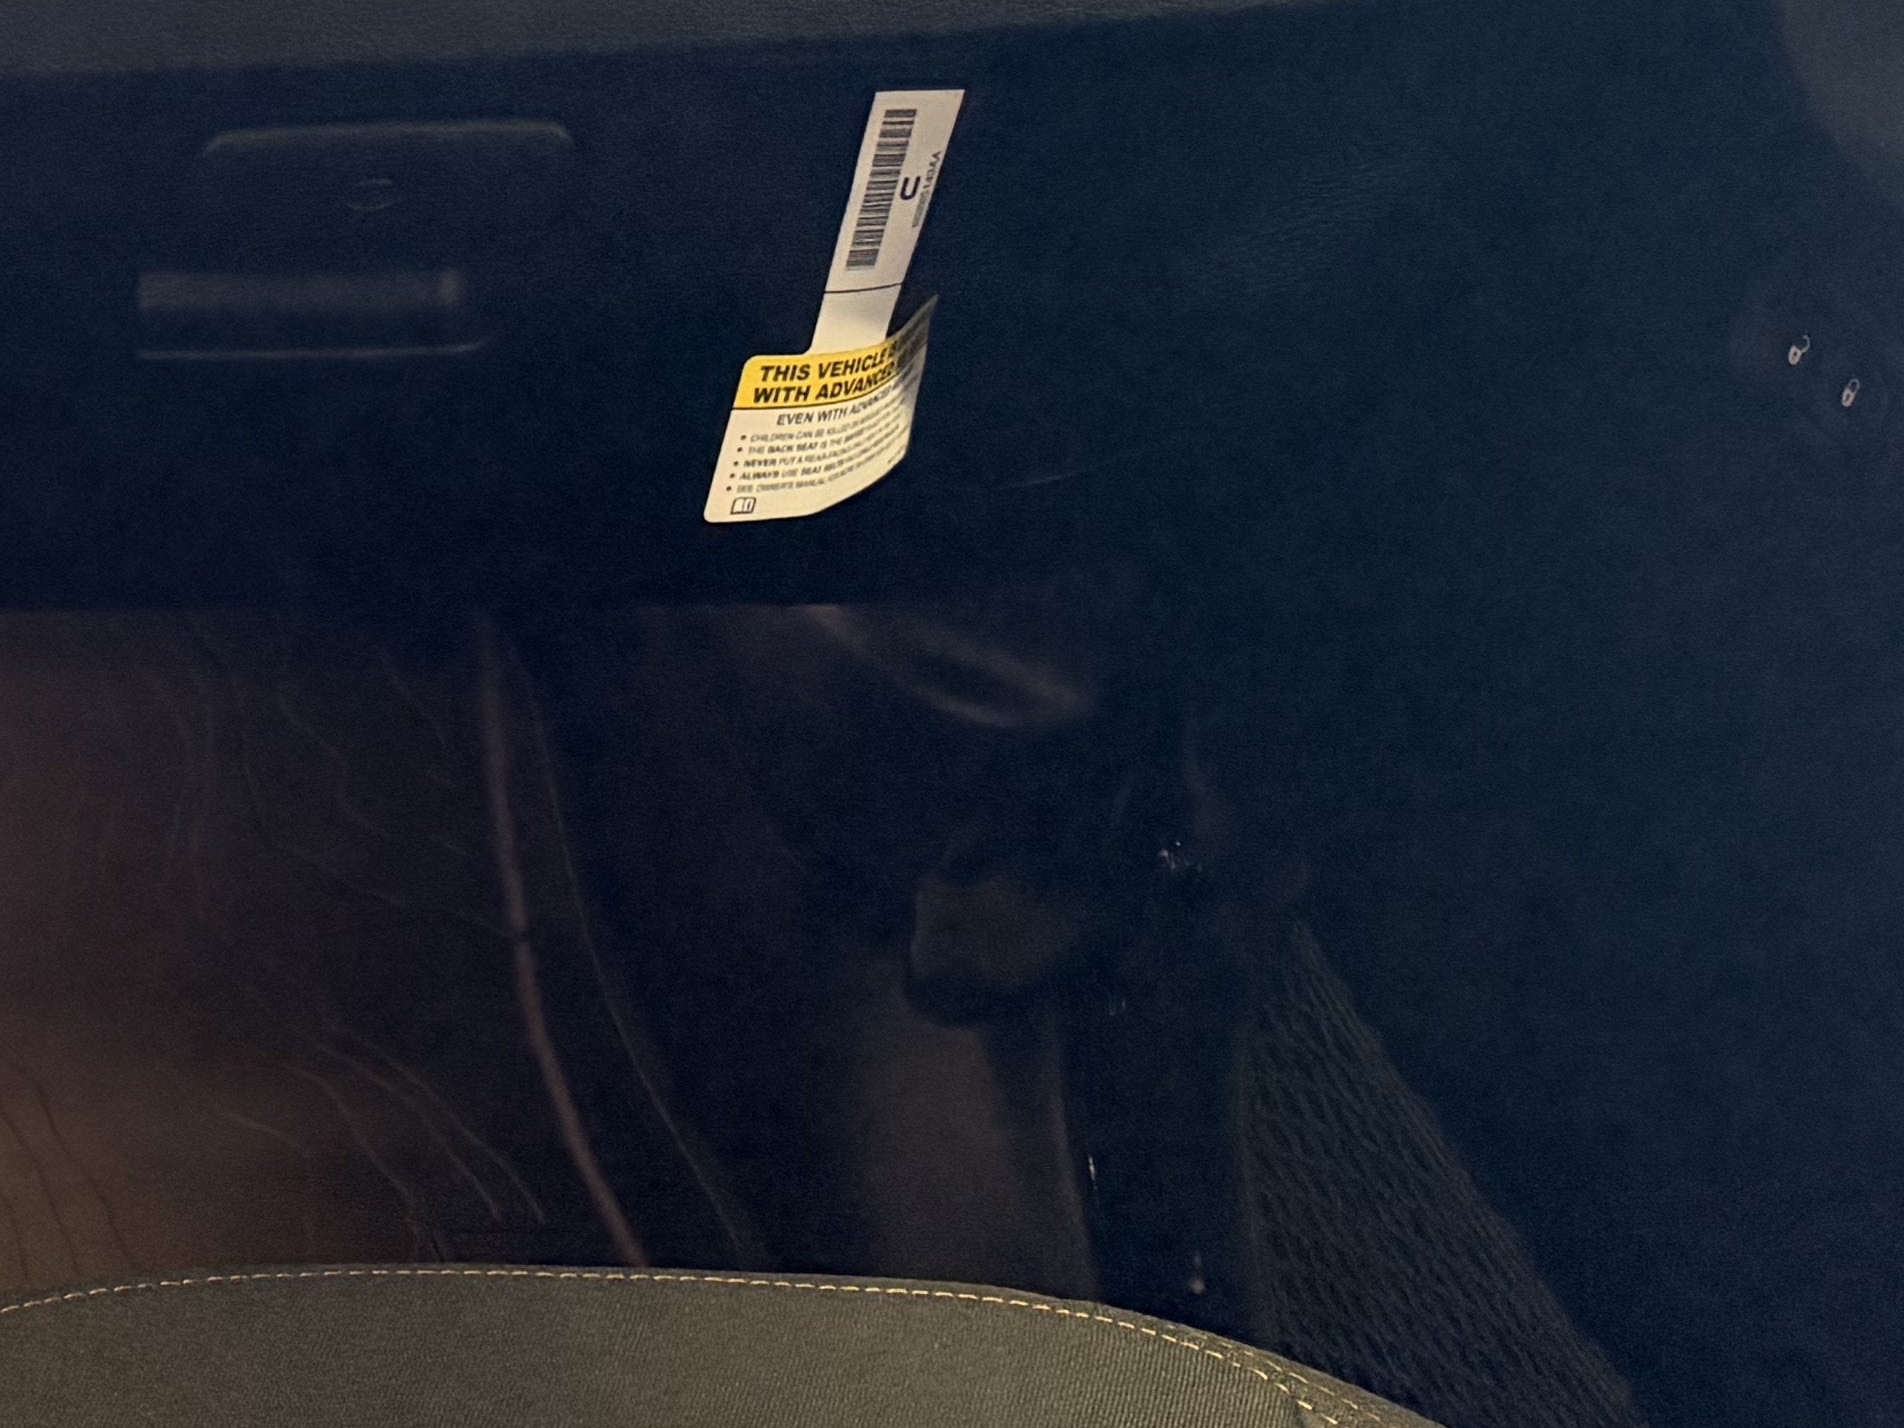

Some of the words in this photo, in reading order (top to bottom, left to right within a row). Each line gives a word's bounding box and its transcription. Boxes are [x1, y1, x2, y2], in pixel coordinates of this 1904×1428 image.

[760, 363, 811, 383] THIS
[818, 347, 888, 379] VEHICLE
[753, 385, 810, 404] WITH
[776, 413, 813, 426] EVEN
[817, 408, 848, 422] WITH
